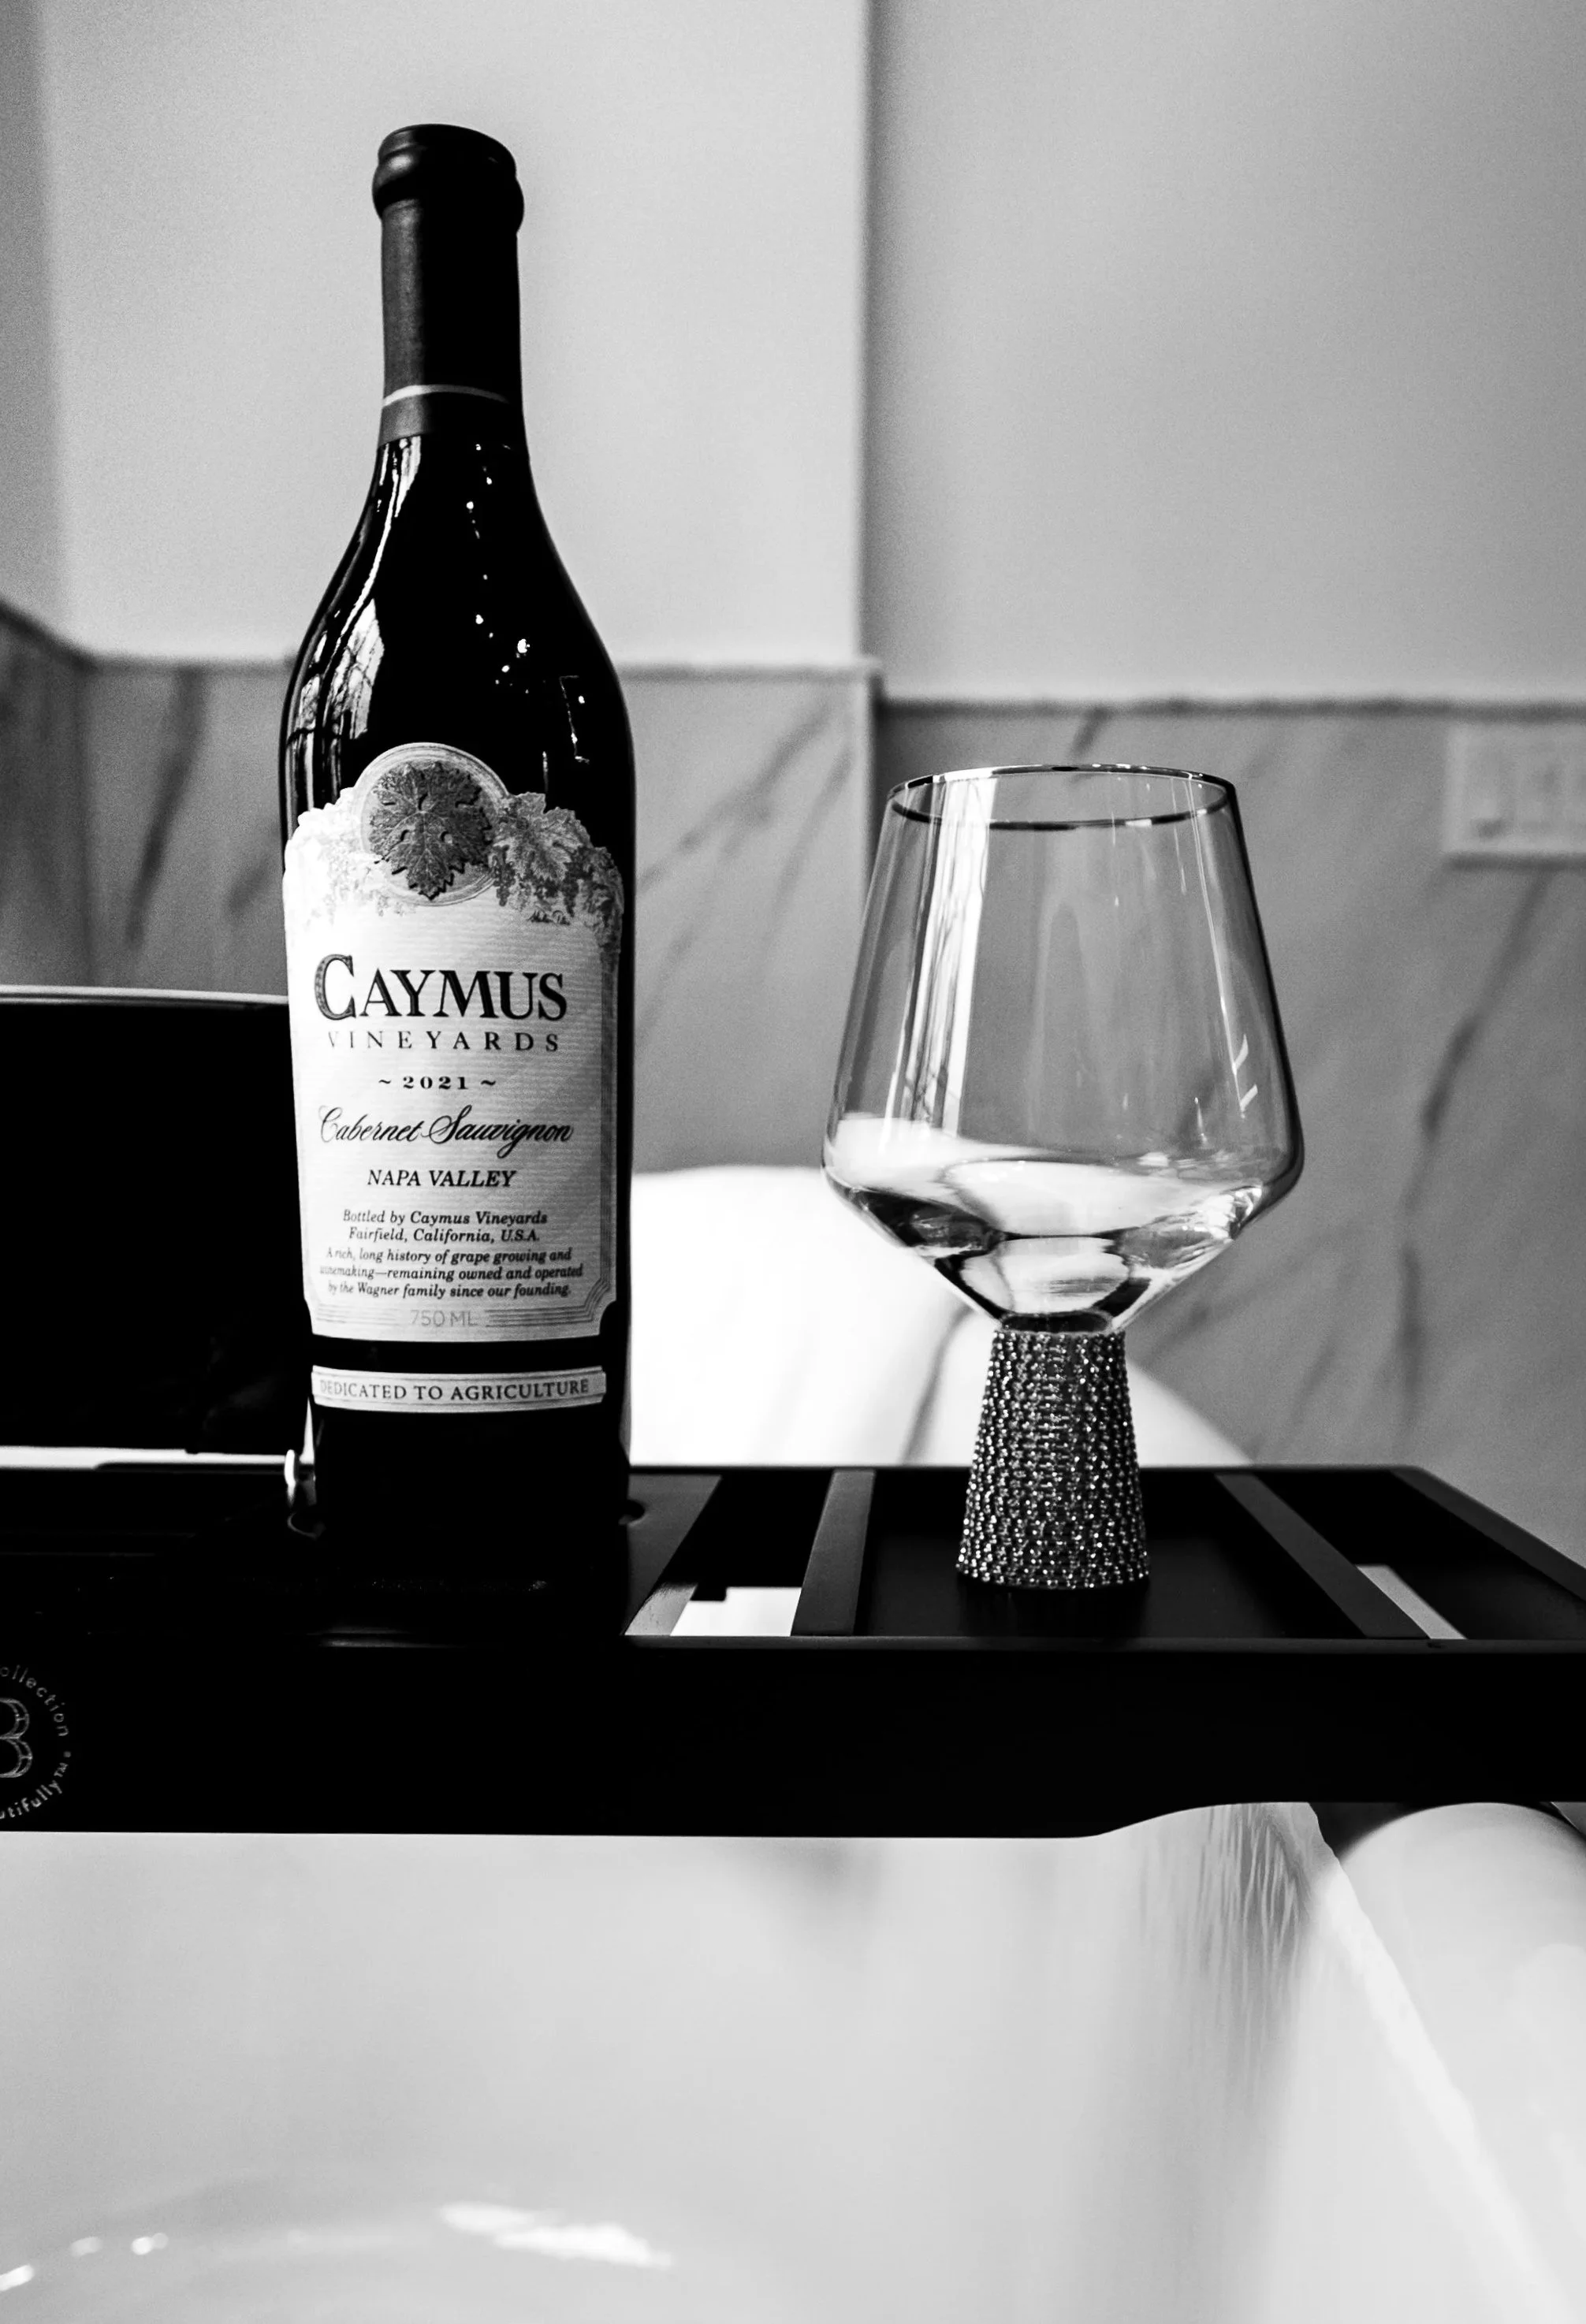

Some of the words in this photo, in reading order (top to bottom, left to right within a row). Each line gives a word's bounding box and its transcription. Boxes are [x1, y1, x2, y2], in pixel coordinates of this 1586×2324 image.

[314, 954, 567, 1021] CAYMUS
[328, 1031, 559, 1051] VINEYARDS
[403, 1076, 469, 1089] 2021
[319, 1106, 425, 1143] Cabernet
[423, 1105, 573, 1158] Sauvignon
[367, 1169, 420, 1186] NAPA
[430, 1170, 517, 1187] VALLEY
[343, 1210, 385, 1223] Bottled
[391, 1210, 405, 1225] by
[410, 1211, 470, 1225] Caymus
[475, 1211, 548, 1225] Vineyards
[348, 1227, 408, 1241] Fairfield,
[413, 1228, 495, 1244] California,
[501, 1228, 540, 1241] U.S.A.
[359, 1248, 384, 1262] long
[387, 1249, 431, 1264] history
[434, 1249, 450, 1264] of
[451, 1252, 490, 1266] grape
[493, 1249, 546, 1264] growing
[549, 1248, 572, 1261] and
[458, 1267, 502, 1279] owned
[506, 1266, 532, 1280] and
[534, 1263, 583, 1281] operated
[340, 1282, 354, 1293] the
[357, 1283, 400, 1297] Wagner
[403, 1284, 446, 1299] family
[450, 1285, 484, 1297] since
[488, 1286, 512, 1297] our
[514, 1282, 571, 1297] founding.
[409, 1310, 445, 1327] 750
[450, 1311, 479, 1326] ML
[320, 1380, 407, 1400] DEDICATED
[414, 1386, 443, 1400] TO
[450, 1378, 589, 1400] AGRICULTURE
[0, 1664, 69, 1737] ollection
